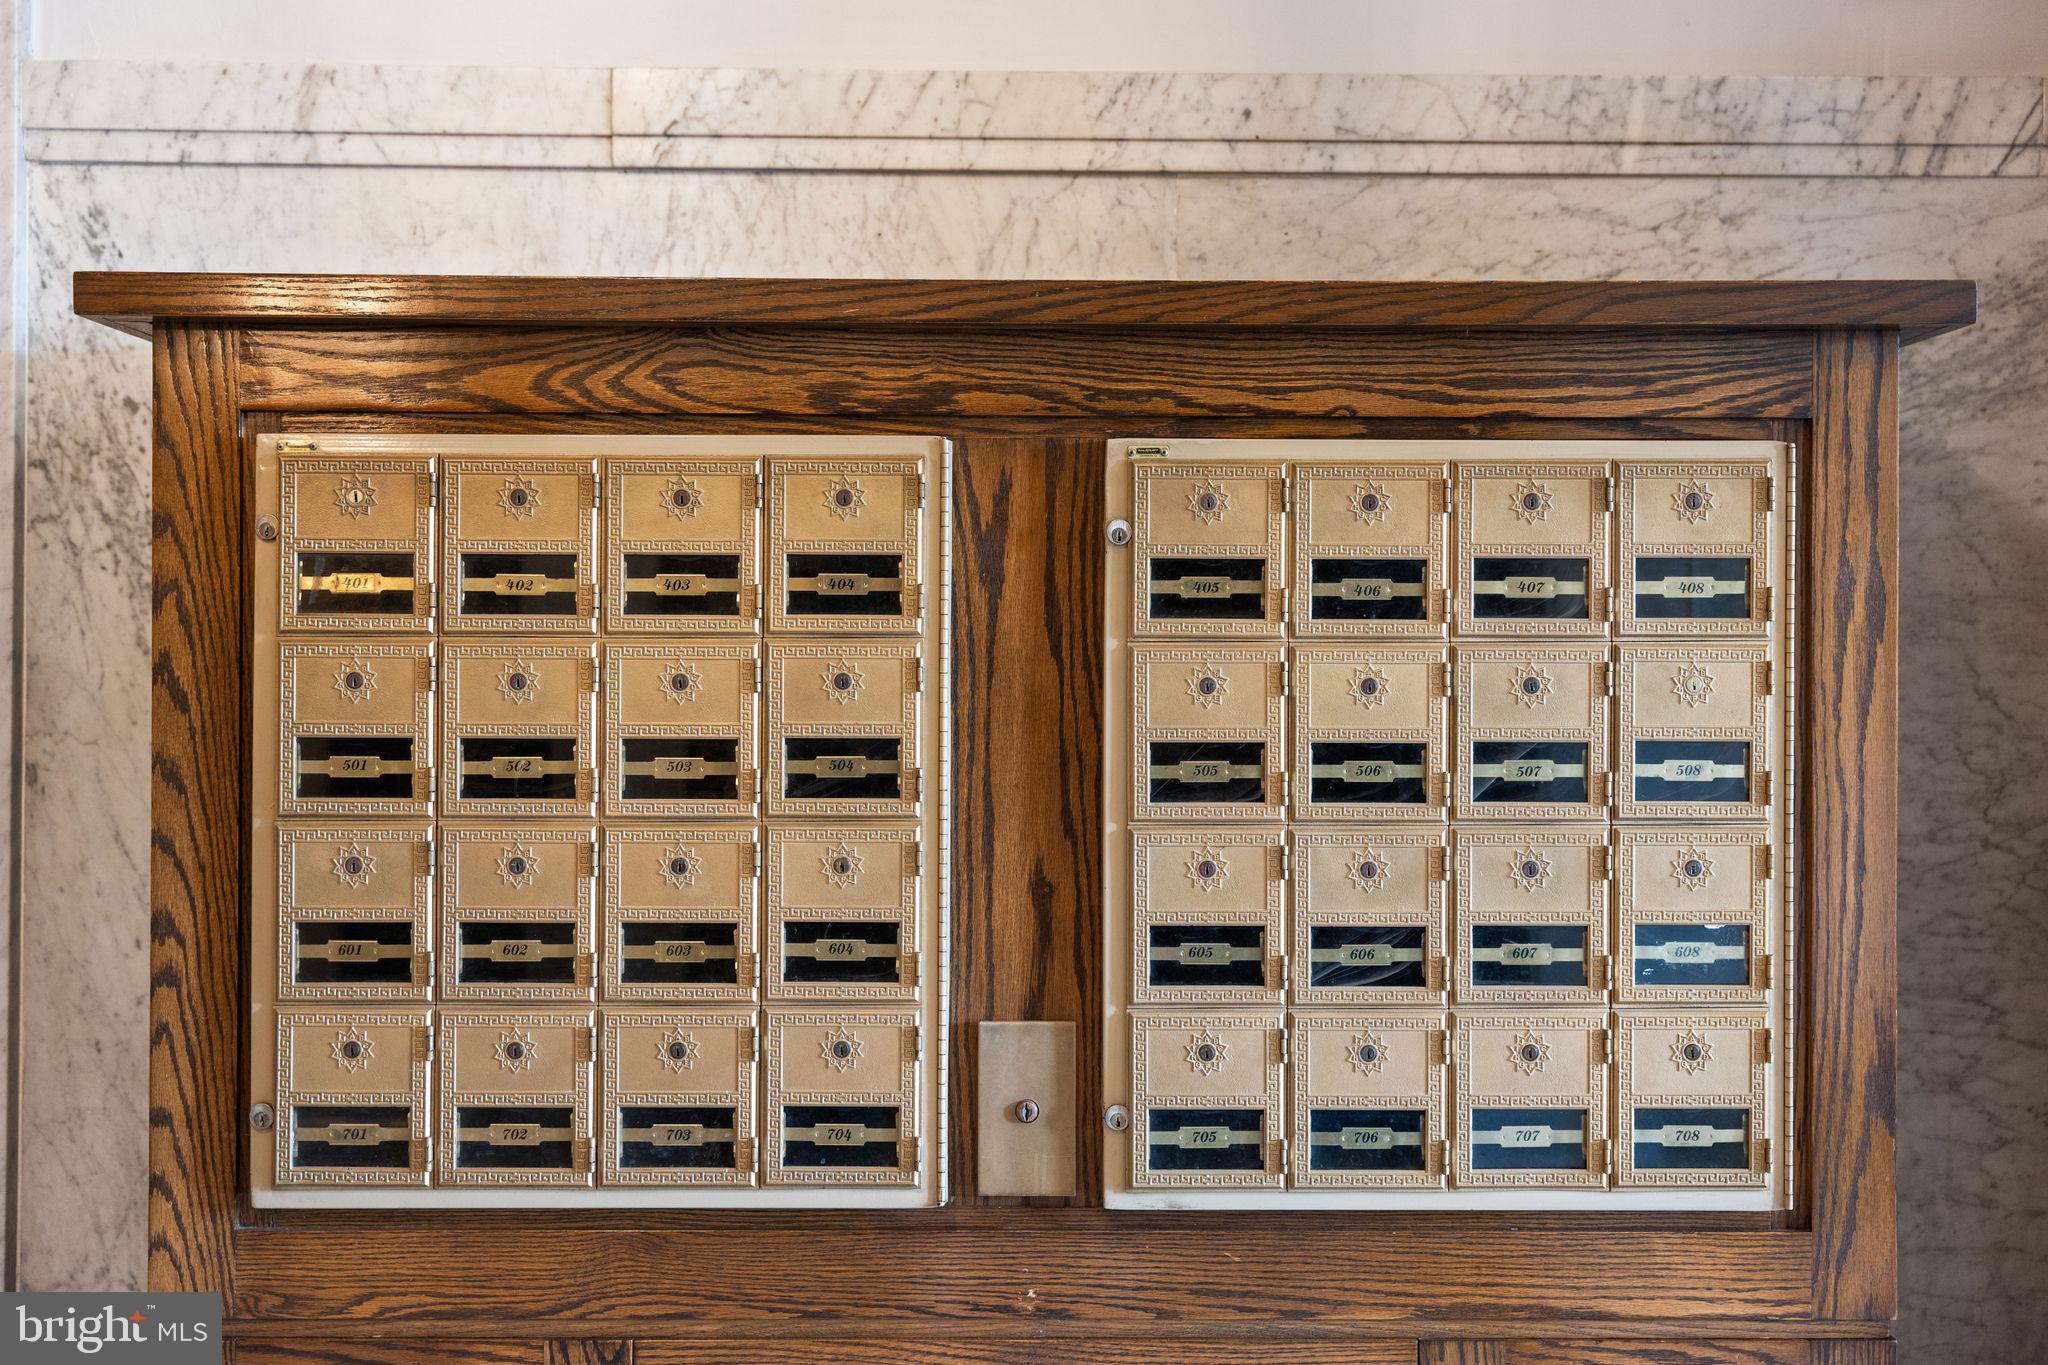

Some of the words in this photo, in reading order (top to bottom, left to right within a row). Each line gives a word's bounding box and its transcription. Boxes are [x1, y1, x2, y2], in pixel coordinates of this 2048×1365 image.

[343, 578, 369, 590] 401
[506, 579, 534, 591] 402
[663, 579, 691, 591] 403
[828, 579, 855, 590] 404
[1194, 582, 1220, 594] 405
[1517, 581, 1544, 593] 407
[1678, 582, 1705, 594] 408
[1354, 585, 1380, 597] 406
[342, 760, 367, 771] 501
[666, 761, 692, 772] 503
[829, 760, 854, 771] 504
[1193, 765, 1218, 776] 505
[1355, 765, 1381, 777] 506
[1676, 765, 1701, 776] 508
[1516, 766, 1541, 778] 507
[338, 944, 362, 956] 601
[503, 944, 527, 956] 602
[666, 945, 692, 956] 603
[829, 943, 853, 955] 604
[1188, 946, 1213, 958] 605
[1350, 949, 1374, 960] 606
[1512, 947, 1537, 959] 607
[1675, 946, 1700, 958] 608
[343, 1128, 368, 1140] 701
[503, 1129, 527, 1140] 702
[667, 1129, 692, 1141] 703
[828, 1128, 852, 1141] 704
[1193, 1131, 1217, 1143] 705
[1354, 1132, 1379, 1143] 706
[1516, 1130, 1541, 1142] 707
[1676, 1130, 1700, 1142] 708
